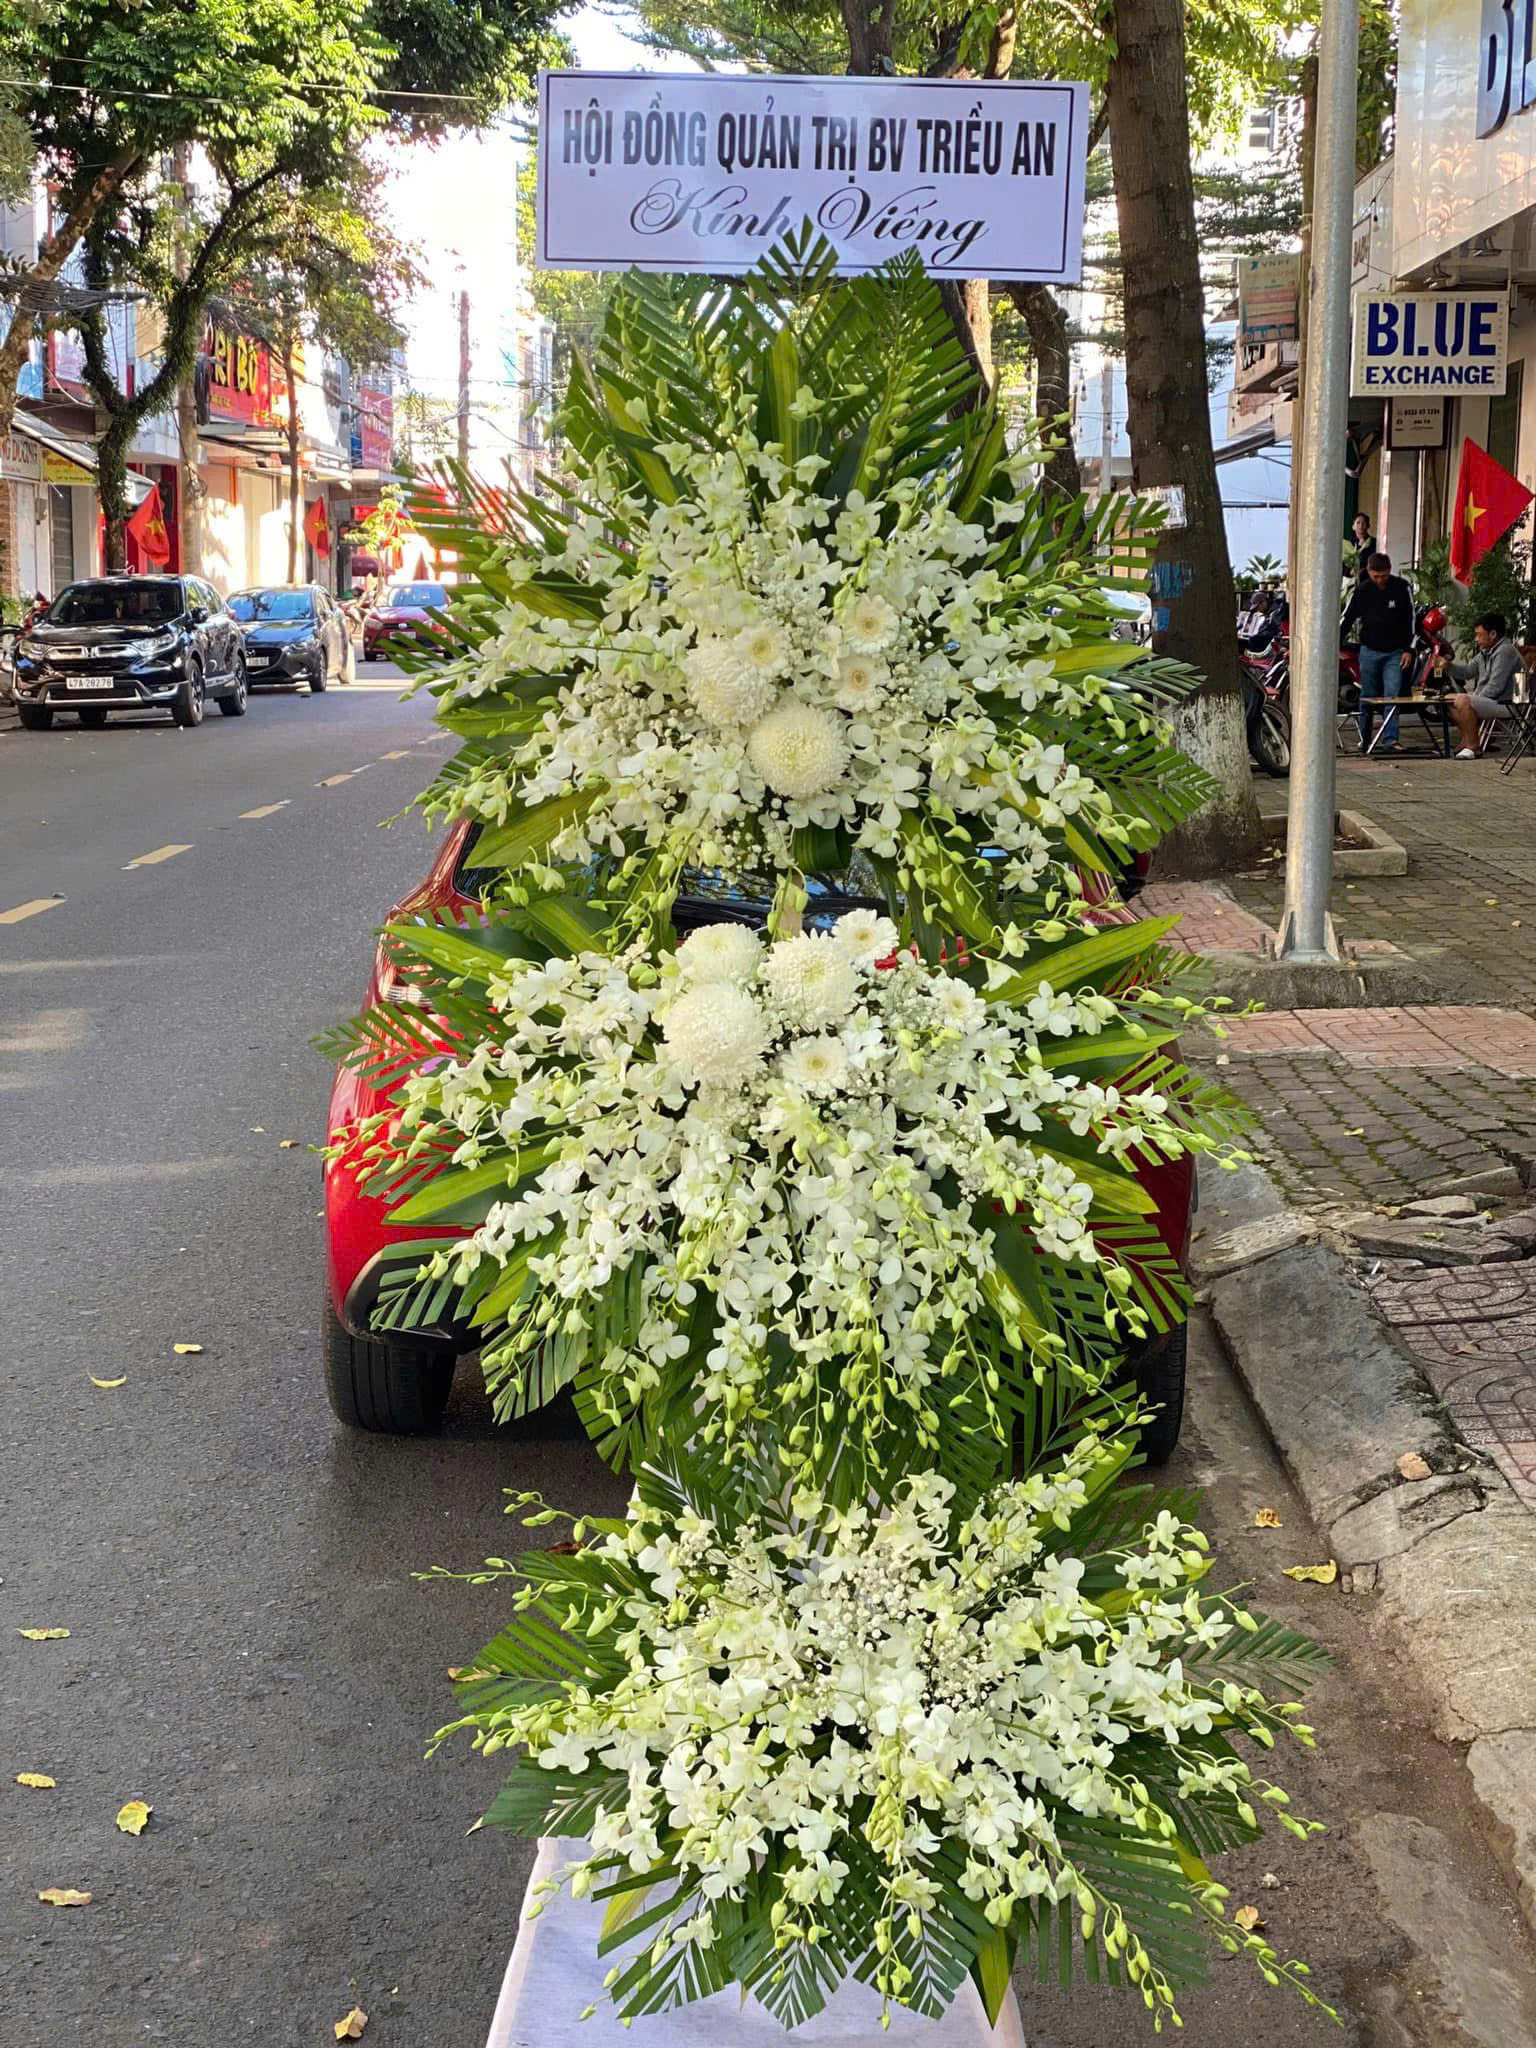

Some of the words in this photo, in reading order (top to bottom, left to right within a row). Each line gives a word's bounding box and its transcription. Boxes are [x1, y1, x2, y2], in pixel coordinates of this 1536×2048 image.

[563, 98, 613, 177] HỘI
[623, 91, 707, 167] ĐỒNG
[717, 95, 800, 174] QUẢN
[811, 116, 858, 183] TRỊ
[868, 117, 907, 172] BV
[916, 101, 1003, 176] TRIỀU
[1011, 121, 1056, 176] AN
[630, 178, 797, 237] Kính
[817, 186, 989, 266] Viếng
[1365, 366, 1496, 385] EXCHANGE
